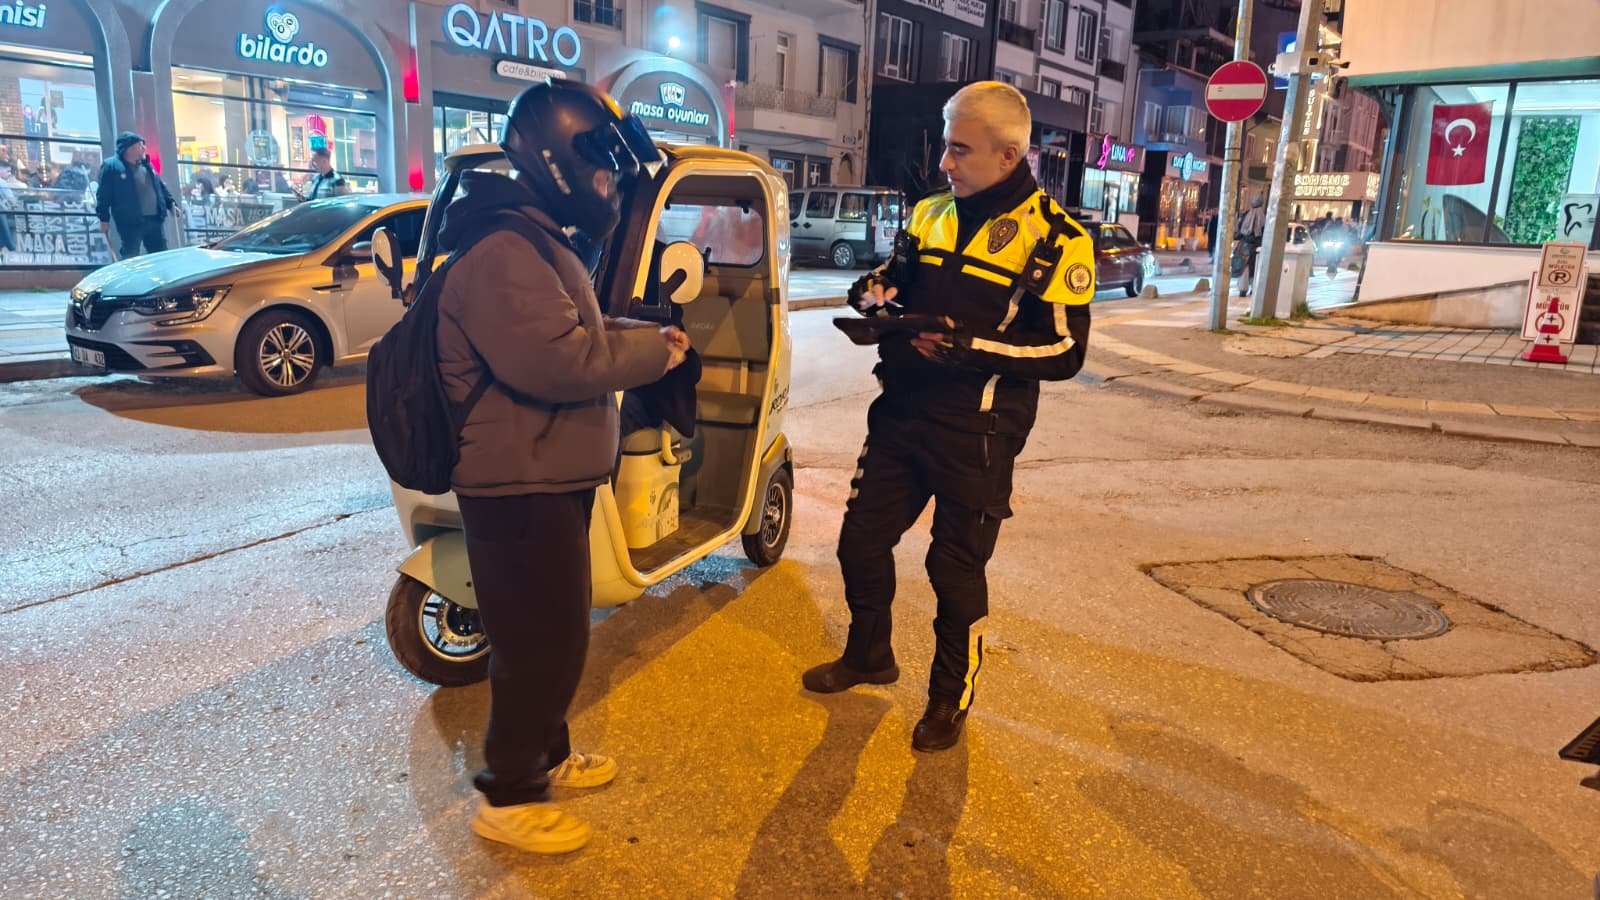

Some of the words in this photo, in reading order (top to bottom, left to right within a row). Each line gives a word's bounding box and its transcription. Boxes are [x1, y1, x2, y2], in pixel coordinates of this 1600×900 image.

[447, 3, 581, 66] QATRO
[240, 33, 328, 67] bilardo
[631, 101, 664, 118] masa
[205, 205, 245, 227] MASA
[16, 233, 66, 254] MASA
